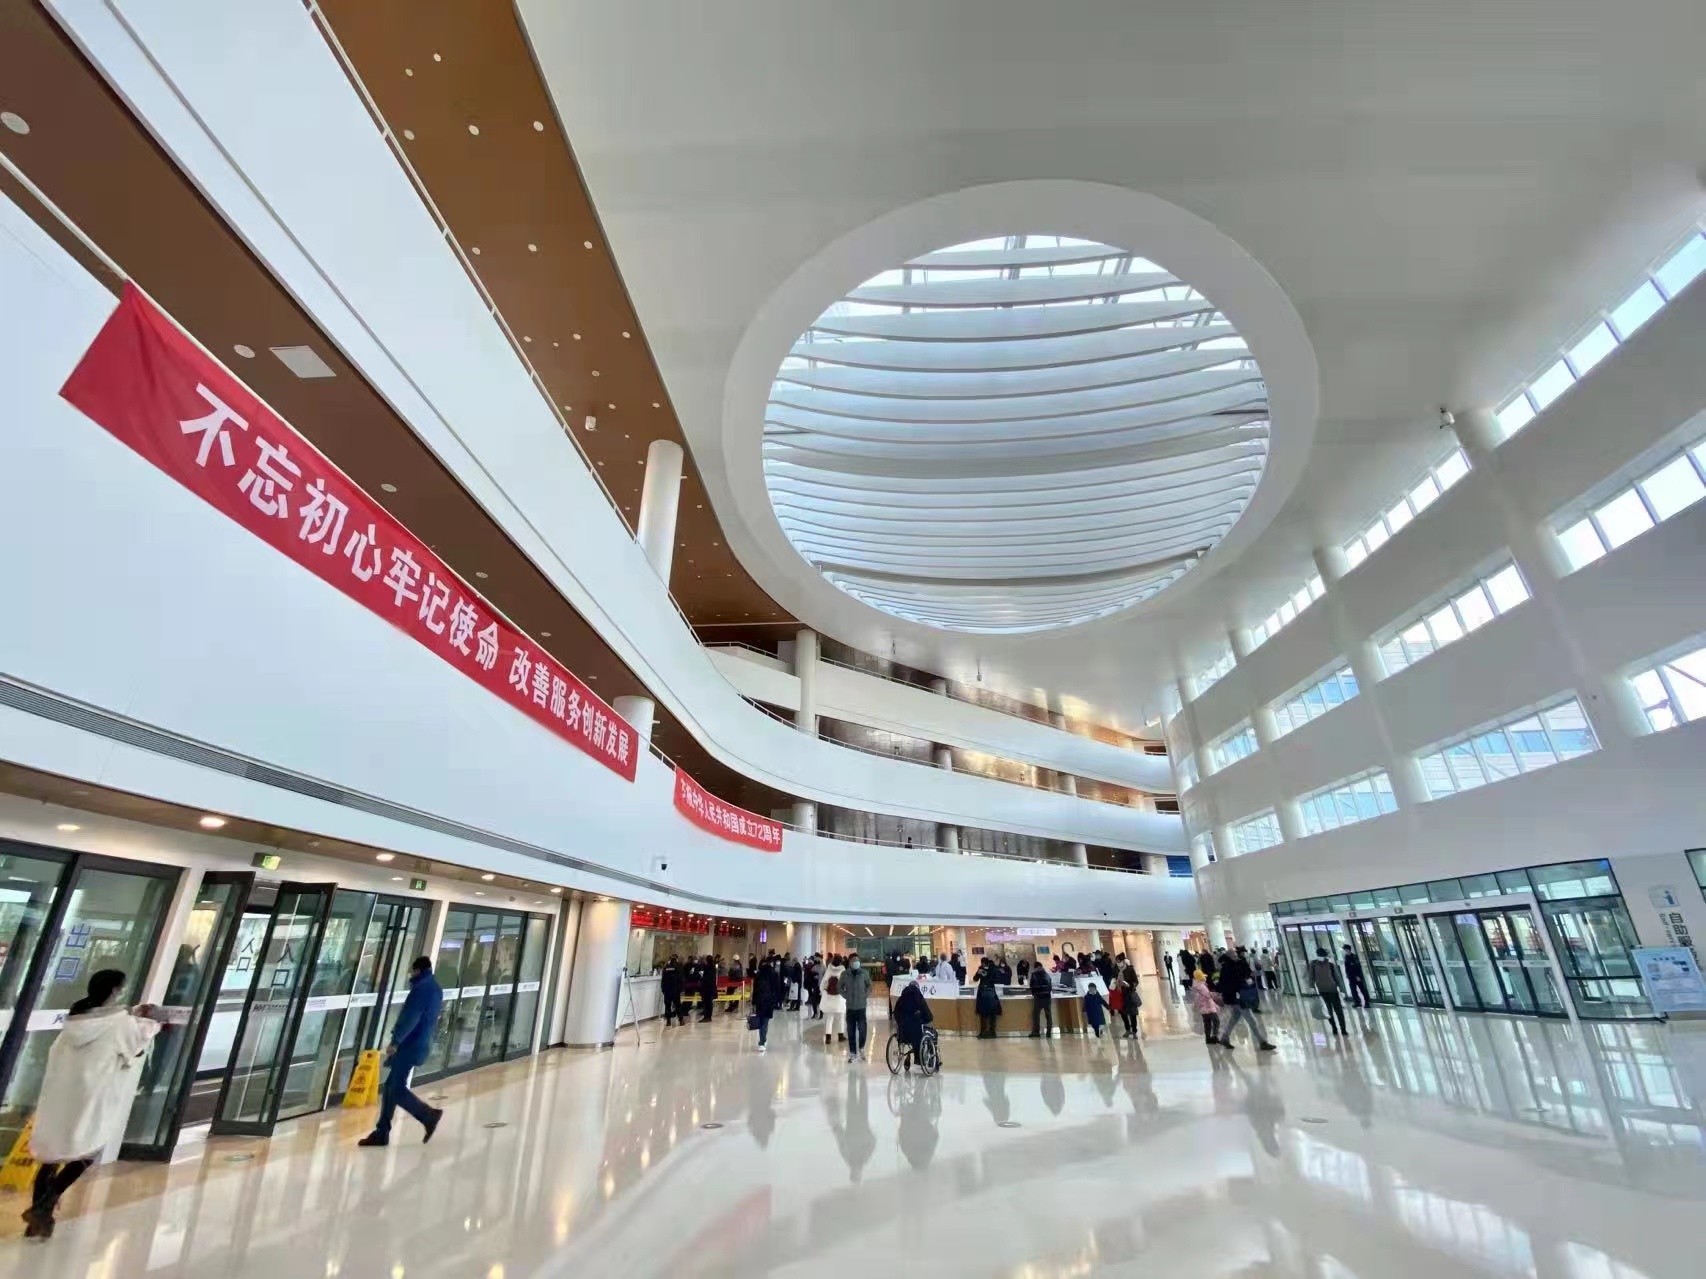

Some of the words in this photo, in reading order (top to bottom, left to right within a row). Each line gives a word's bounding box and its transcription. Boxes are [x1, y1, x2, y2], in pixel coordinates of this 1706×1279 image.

[180, 382, 500, 671] 不忘初心牢记使命
[508, 647, 629, 767] 改善服务创新发展
